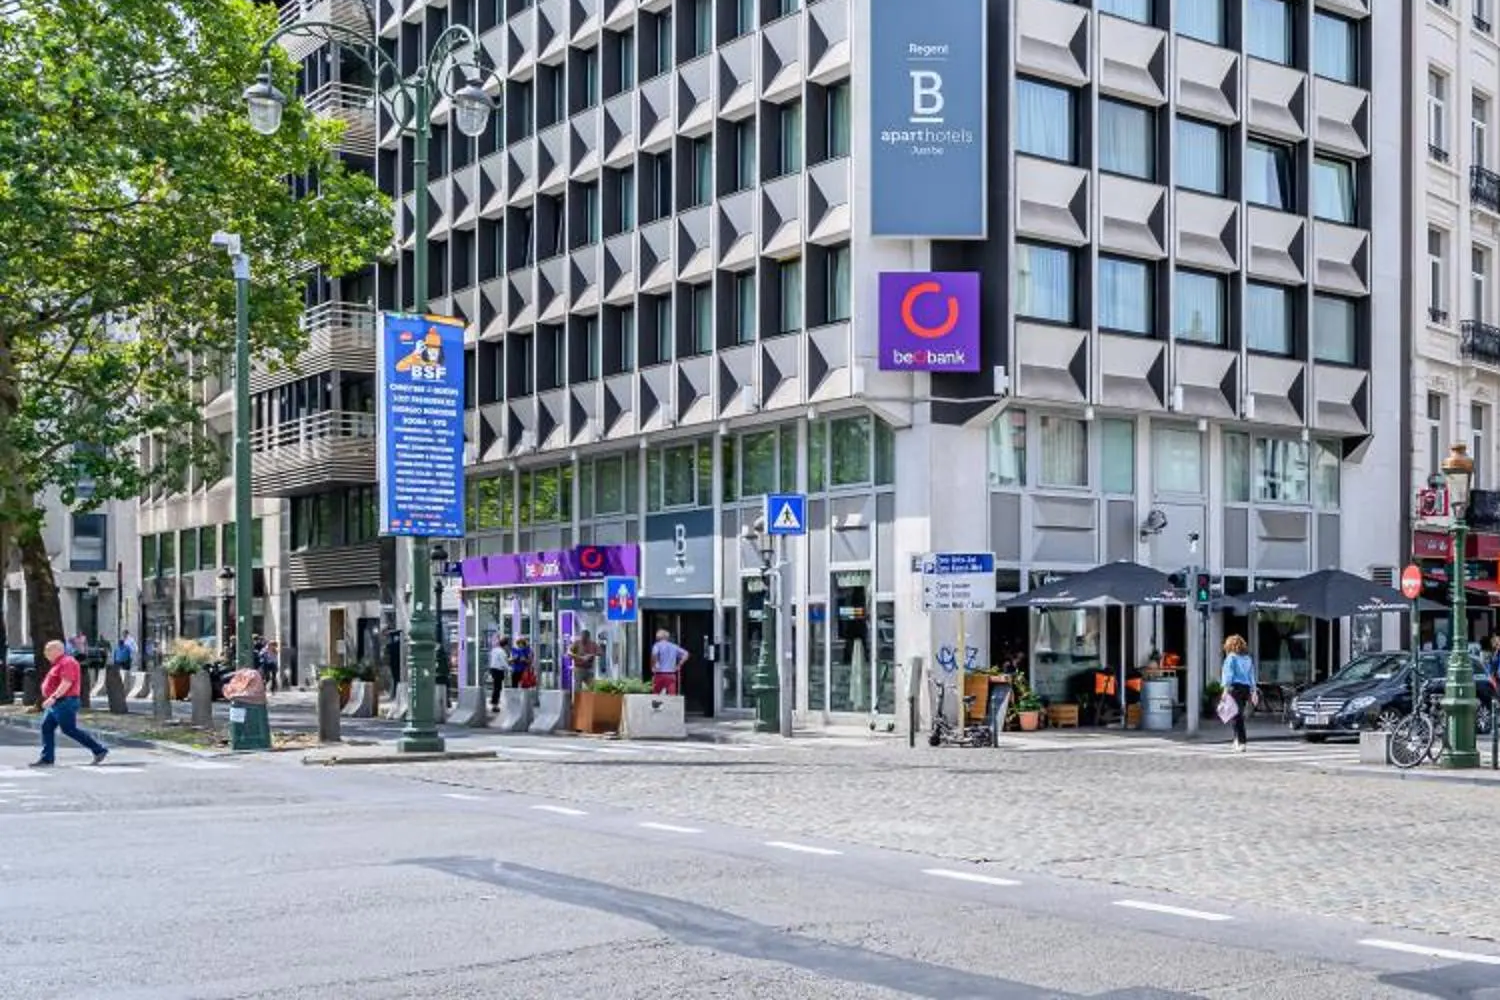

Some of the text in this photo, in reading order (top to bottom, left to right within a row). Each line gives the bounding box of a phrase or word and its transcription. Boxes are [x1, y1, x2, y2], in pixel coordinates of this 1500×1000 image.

[909, 43, 949, 56] Regent
[909, 71, 945, 115] B
[880, 127, 973, 144] aparthotels
[411, 365, 447, 379] BSF
